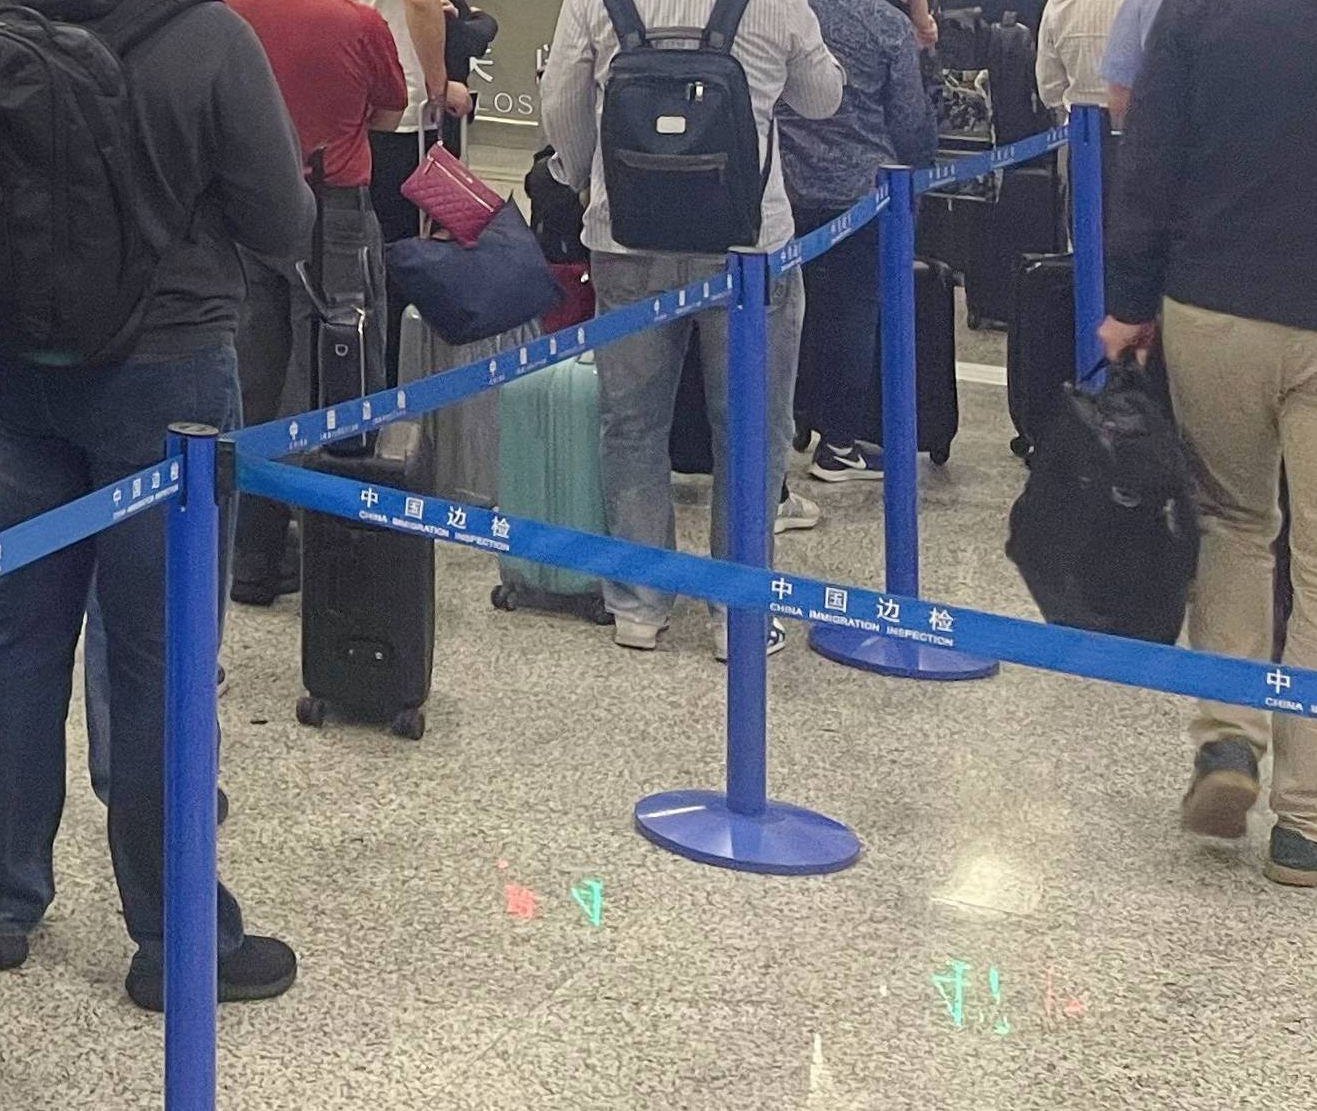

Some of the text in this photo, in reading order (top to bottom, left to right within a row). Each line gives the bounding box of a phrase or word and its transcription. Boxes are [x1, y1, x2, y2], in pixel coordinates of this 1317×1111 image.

[475, 92, 534, 115] LOS
[360, 487, 511, 539] 中国边检
[769, 602, 954, 647] CHINA IMMIGRATION INSPECTION
[771, 577, 954, 633] 中国边检
[1266, 668, 1291, 695] 中
